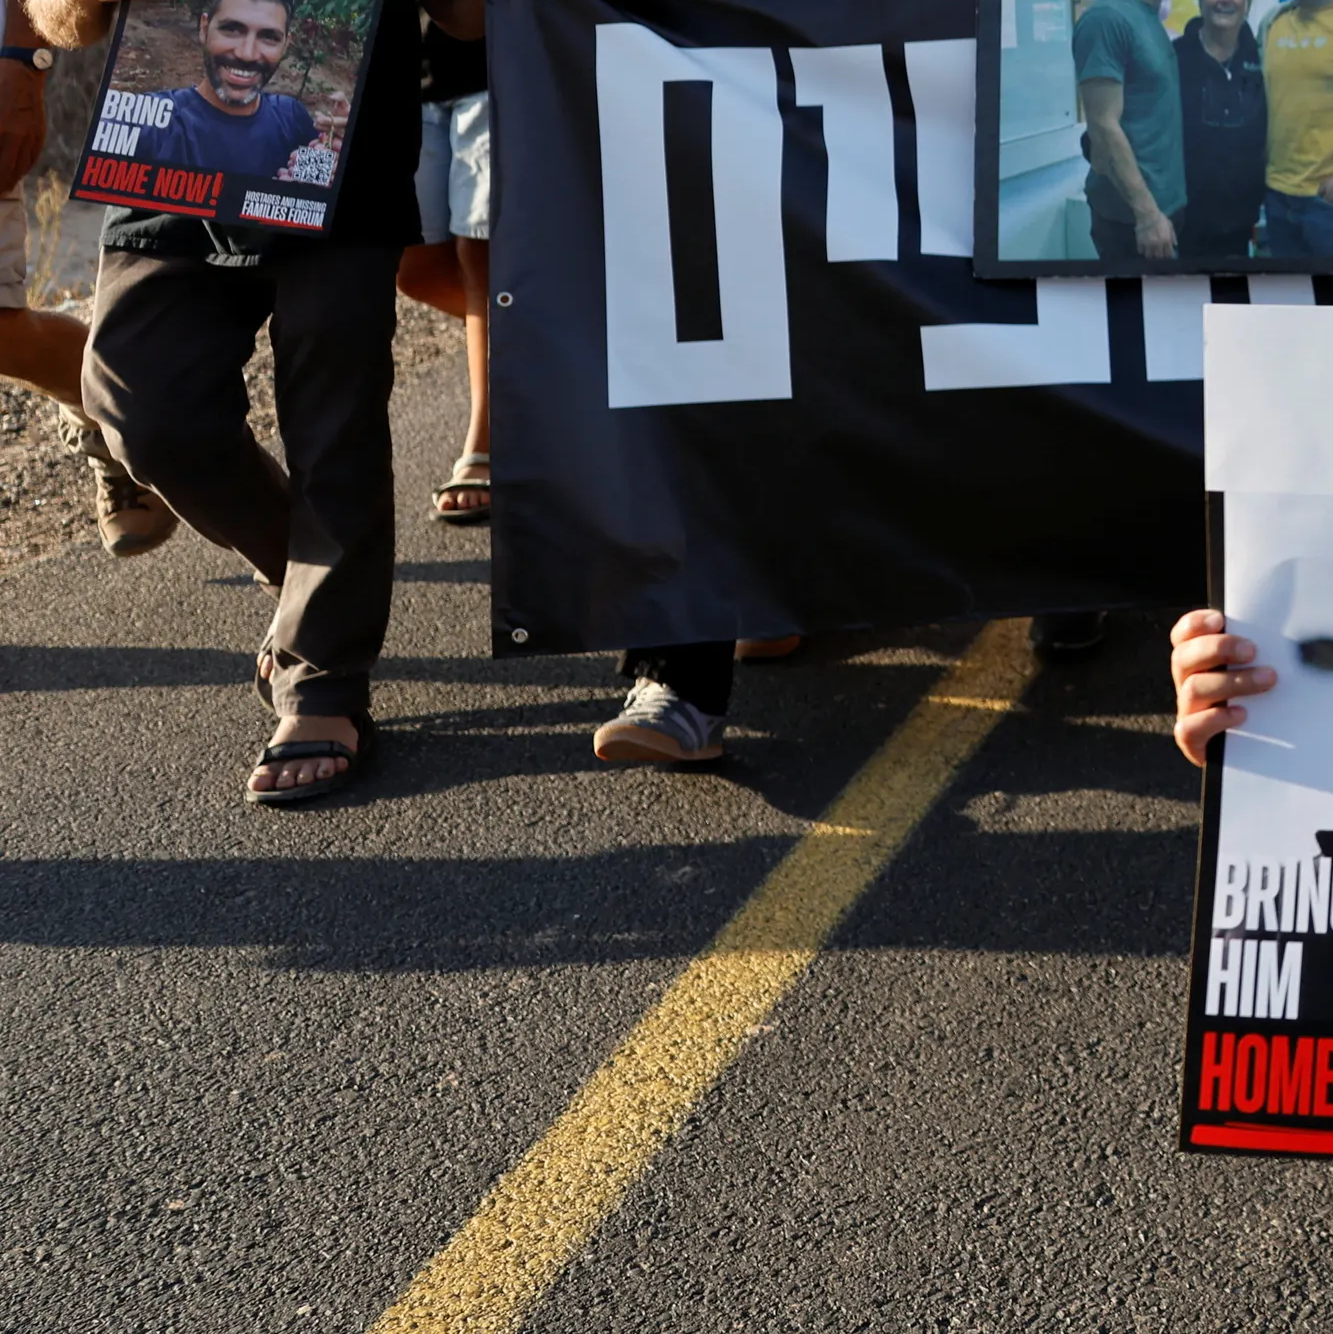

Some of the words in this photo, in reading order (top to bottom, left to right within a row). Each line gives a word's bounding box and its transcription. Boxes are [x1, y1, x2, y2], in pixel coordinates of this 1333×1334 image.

[100, 89, 174, 129] BRING
[92, 121, 141, 157] HIM
[81, 156, 152, 192] HOME
[153, 167, 224, 206] NOW!
[241, 201, 290, 222] FAMILIES
[290, 207, 325, 227] FORUM
[244, 190, 282, 204] HOSTAGES
[280, 196, 296, 207] AND
[296, 198, 327, 212] MISSING
[1205, 938, 1303, 1020] HIM
